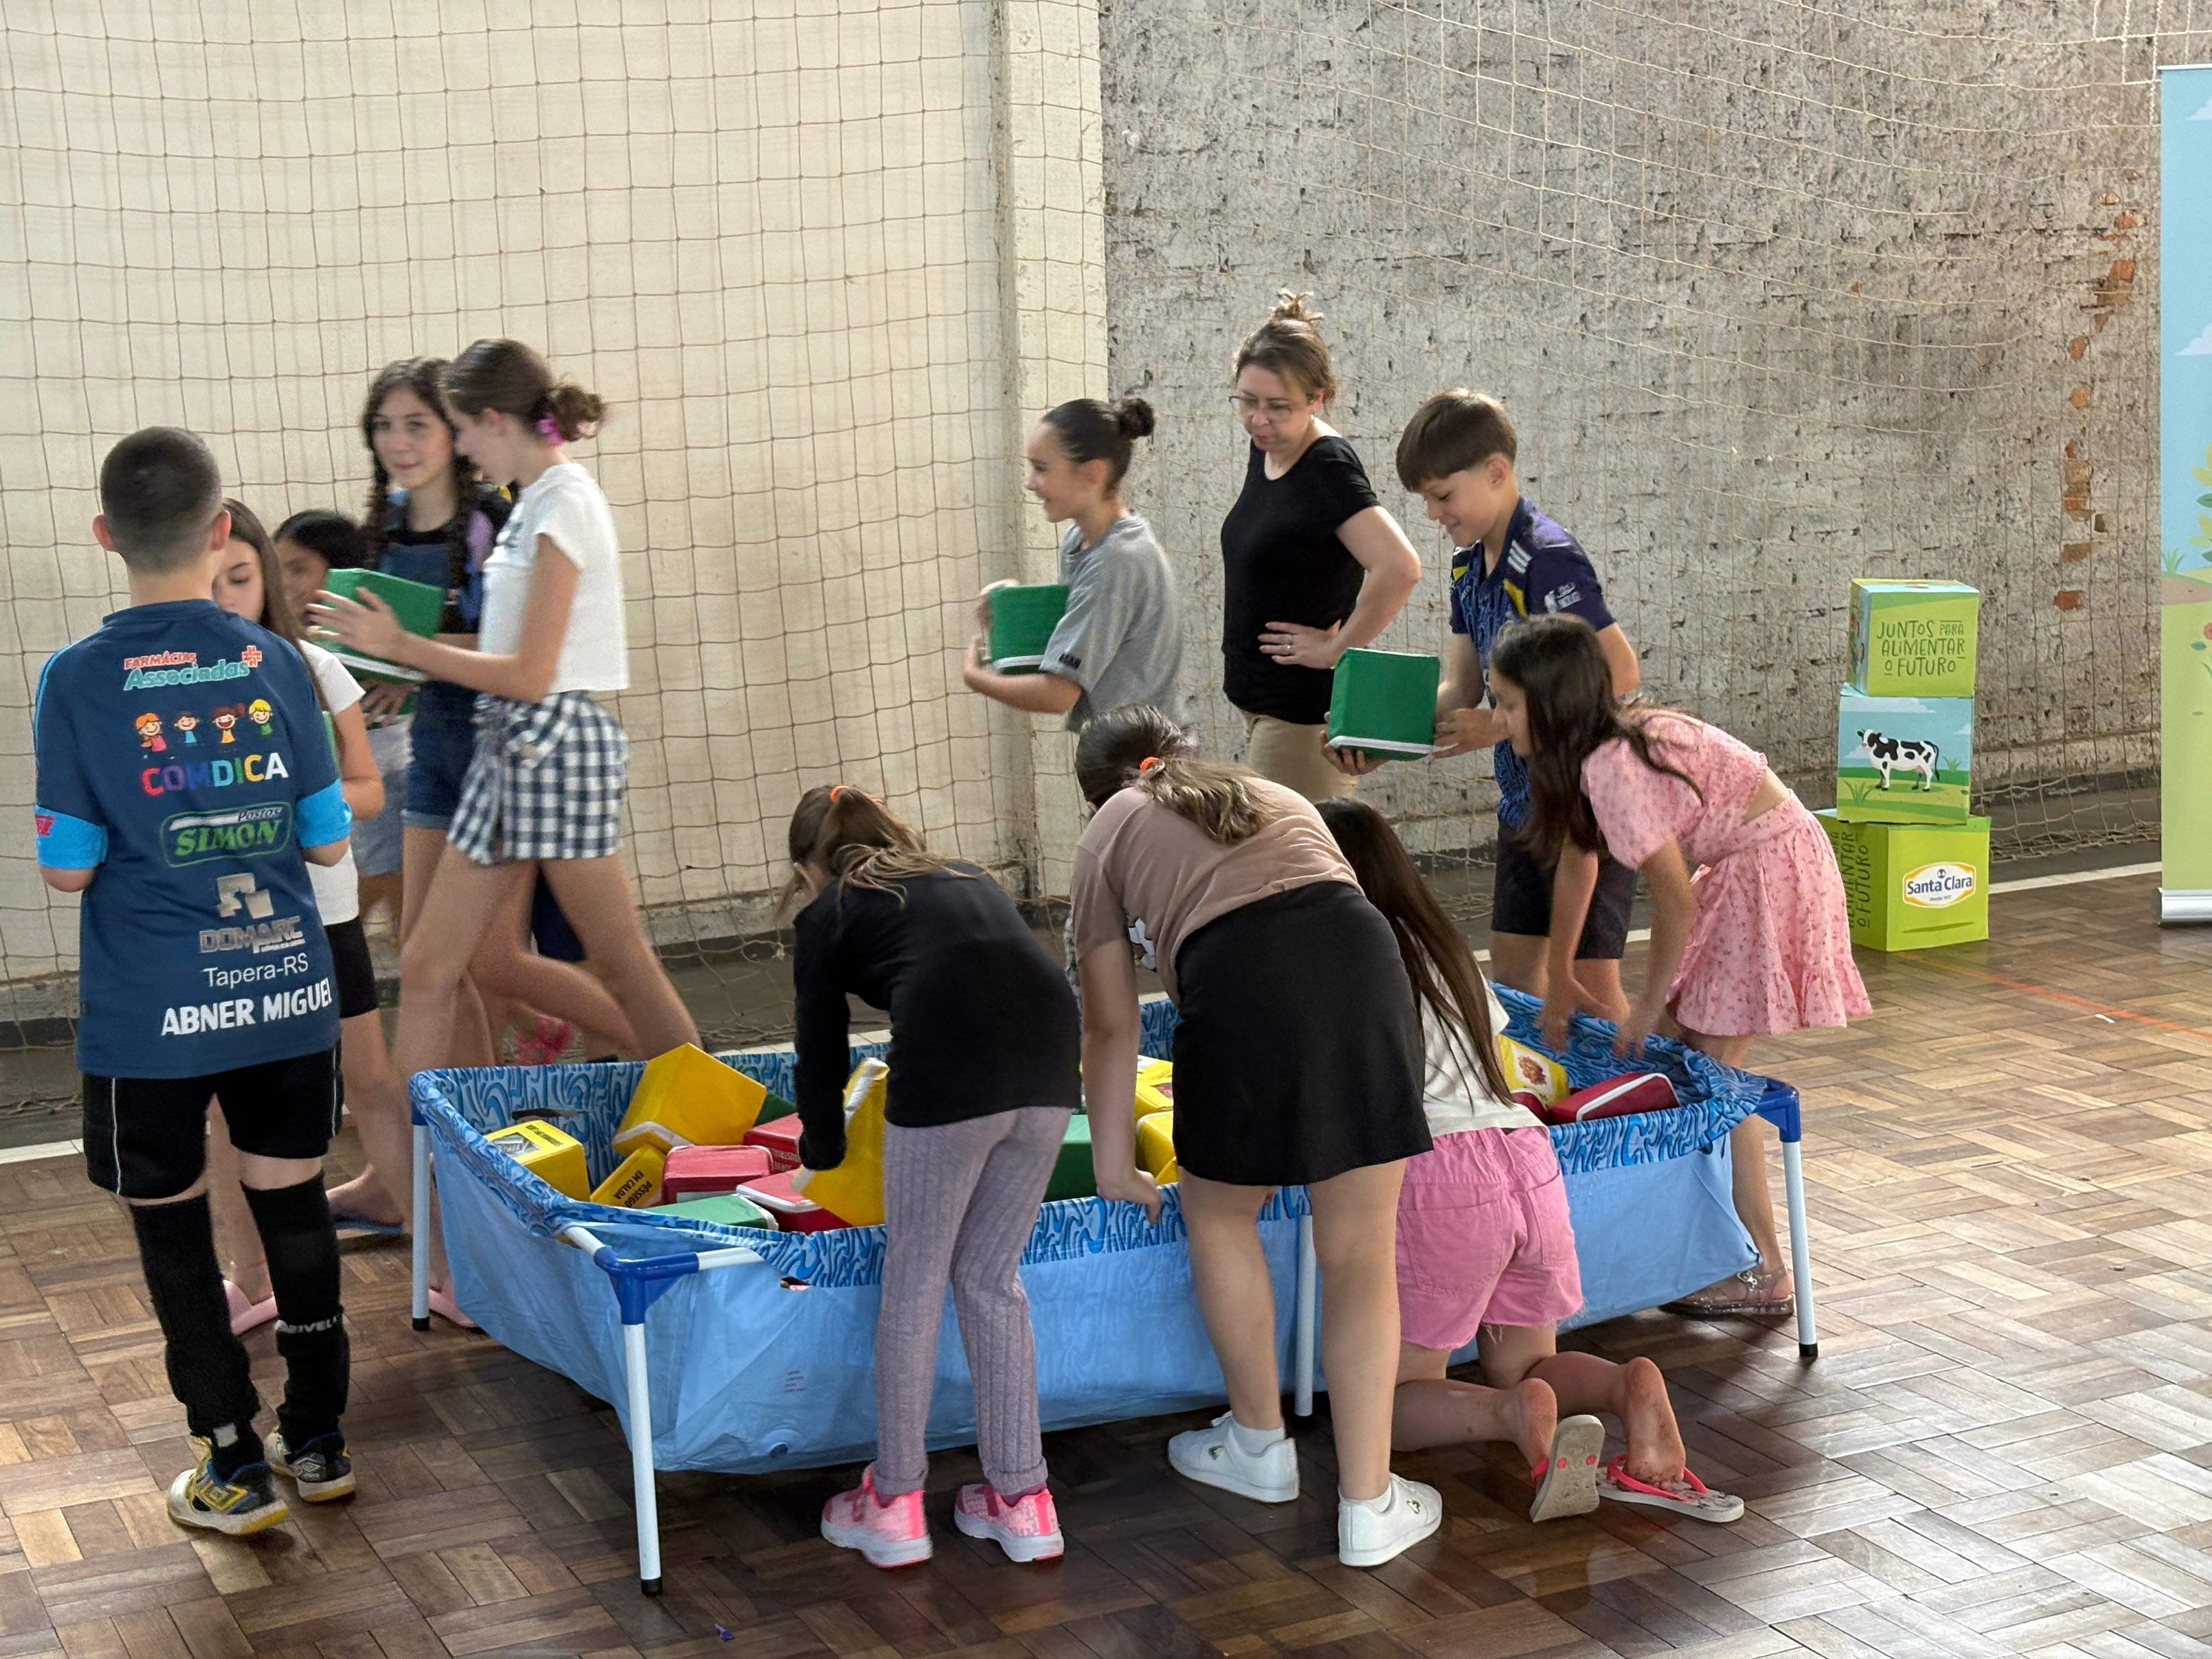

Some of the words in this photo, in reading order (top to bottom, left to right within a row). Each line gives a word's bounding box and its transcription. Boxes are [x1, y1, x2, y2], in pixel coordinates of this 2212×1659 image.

[1876, 620, 1934, 640] JUNTOS
[1939, 623, 1964, 636] PARA
[123, 651, 197, 670] FARMÁCIAS
[1897, 657, 1956, 677] FUTURO
[123, 659, 250, 691] Associadas
[141, 752, 290, 795] COMDICA
[238, 806, 284, 823] Postos
[174, 819, 283, 857] SIMON
[1854, 844, 1872, 914] FUTURO
[1907, 879, 1942, 895] Santa
[1944, 876, 1973, 890] Clara
[202, 952, 308, 989] Tapera-RS
[160, 998, 256, 1036] ABNER
[263, 977, 332, 1022] MIGUEL
[631, 1170, 645, 1182] EM
[613, 1179, 635, 1200] CALDA
[624, 1180, 653, 1208] PÉSSEGO
